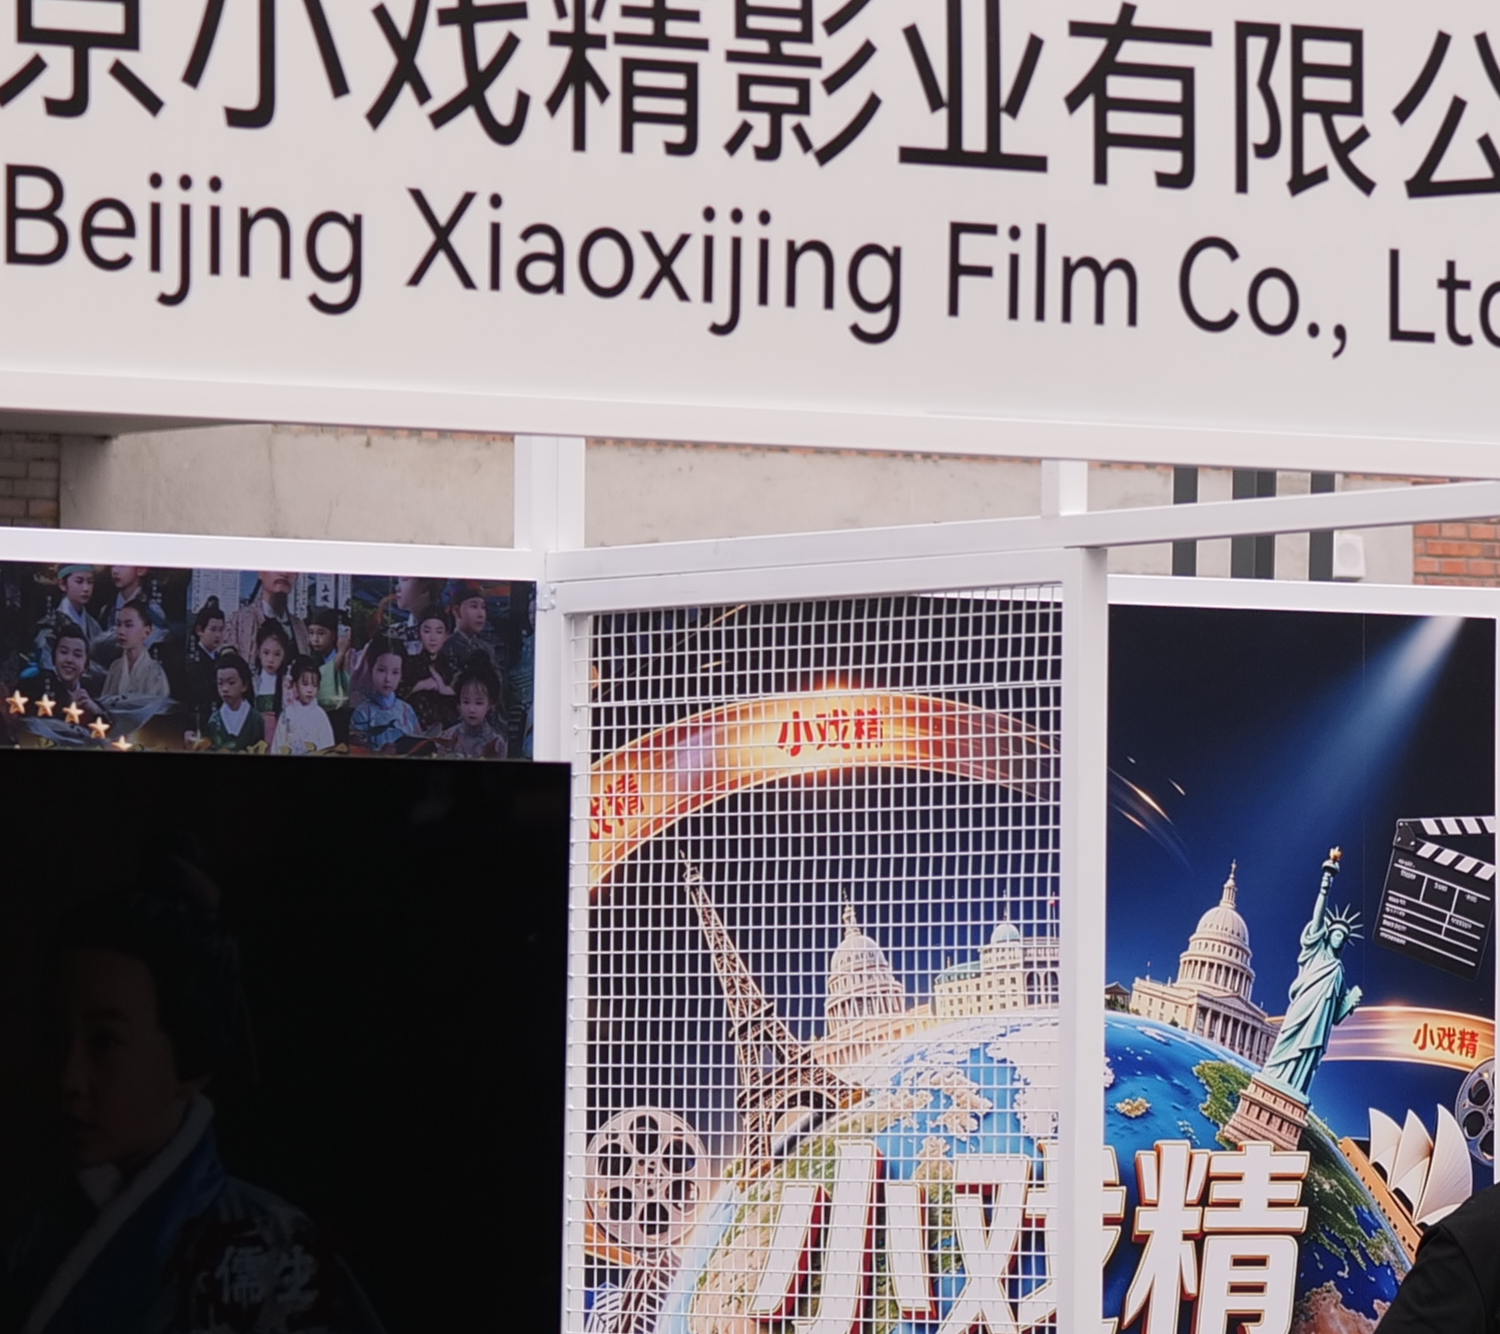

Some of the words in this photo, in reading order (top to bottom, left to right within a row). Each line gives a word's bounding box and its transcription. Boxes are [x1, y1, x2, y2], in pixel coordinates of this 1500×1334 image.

[3, 162, 364, 316] Beijing
[404, 187, 902, 345] Xiaoxijing
[946, 220, 1139, 329] Film
[1177, 234, 1349, 360] Co.,
[776, 706, 885, 757] 小戏精
[1413, 1022, 1480, 1059] 小戏精
